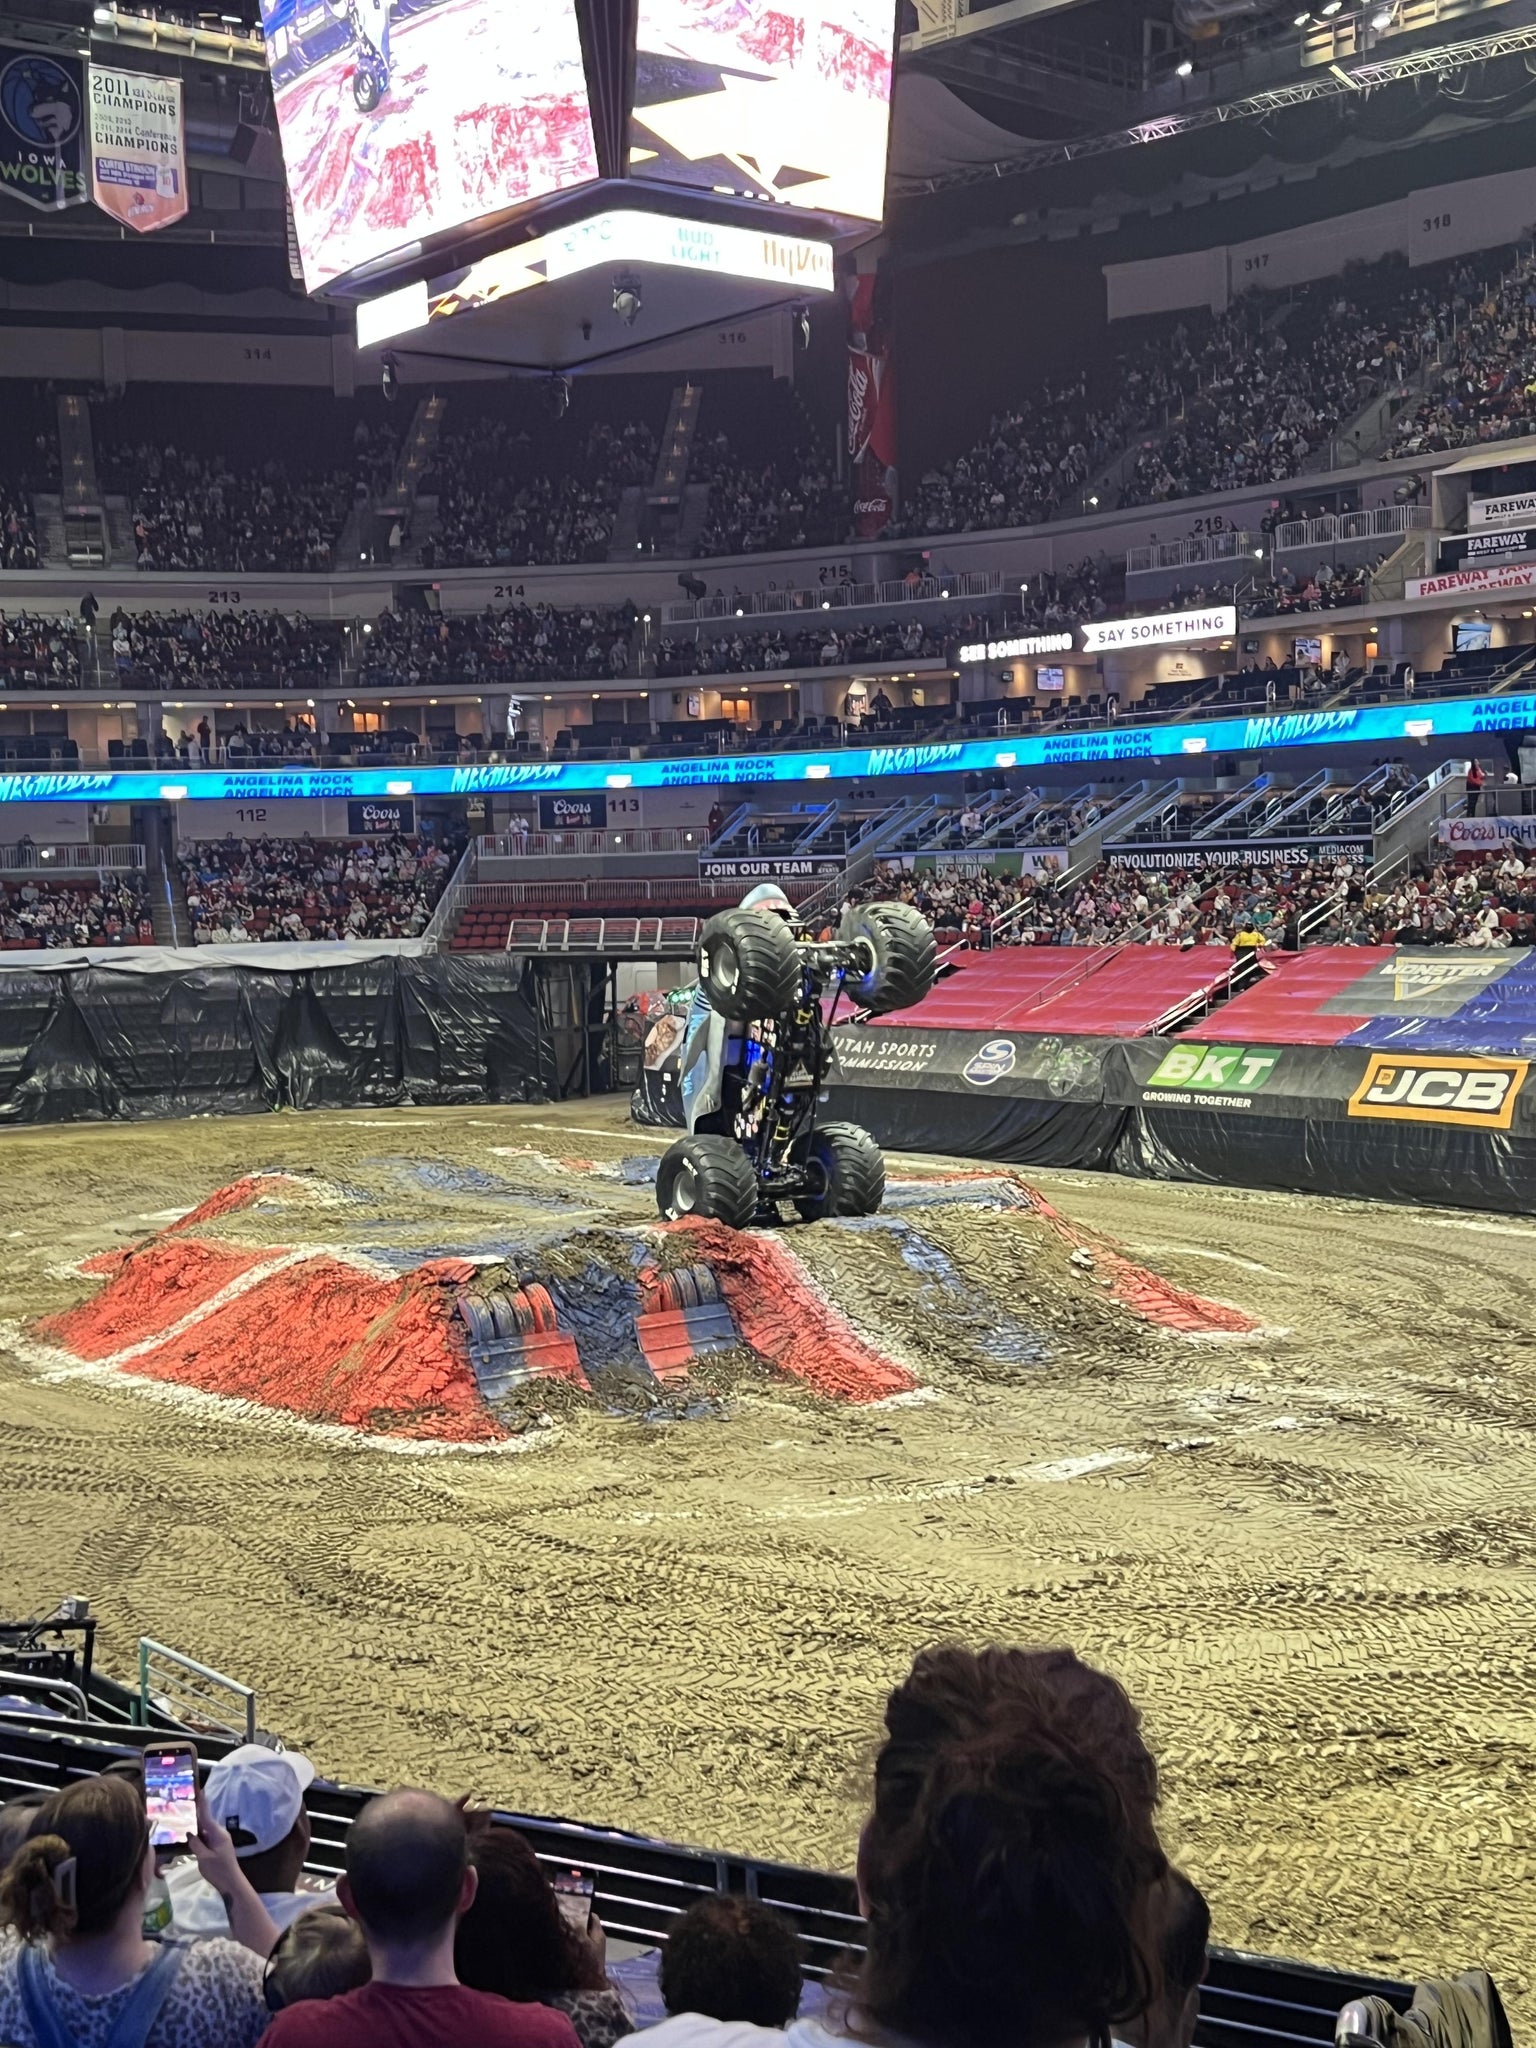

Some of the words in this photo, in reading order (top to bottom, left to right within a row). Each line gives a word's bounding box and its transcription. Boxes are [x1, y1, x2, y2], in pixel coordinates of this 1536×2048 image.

[93, 76, 129, 96] 2011
[94, 93, 176, 116] CHAMPIONS
[96, 132, 178, 154] CHAMPIONS
[18, 150, 66, 168] IOWA
[0, 161, 86, 192] WOLVES
[1486, 498, 1536, 514] FAREWA
[1194, 516, 1223, 533] 216
[1468, 532, 1527, 550] FAREWAY
[818, 564, 849, 578] 215
[494, 584, 525, 598] 214
[1420, 570, 1489, 596] FAREWAY
[208, 591, 241, 604] 213
[1099, 630, 1126, 644] SAY
[1131, 616, 1224, 640] SOMETHING
[960, 644, 986, 662] SEE
[988, 632, 1073, 660] SOMETHING
[1044, 735, 1108, 750] ANGELINA
[1113, 732, 1152, 744] NOCK
[1044, 749, 1108, 764] ANGELINA
[662, 760, 730, 774] ANGELINA
[734, 759, 774, 770] NOCK
[224, 776, 304, 786] ANGELINA
[309, 775, 354, 785] NOCK
[662, 773, 730, 786] ANGELINA
[224, 788, 304, 798] ANGELINA
[362, 804, 400, 820] Coors
[553, 799, 591, 814] Coors
[608, 800, 640, 812] 113
[236, 808, 267, 822] 112
[1450, 822, 1495, 840] Coors
[1318, 845, 1364, 854] MEDIACOM
[1110, 852, 1200, 868] REVOLUTIONIZE
[1205, 851, 1240, 866] YOUR
[1244, 849, 1309, 864] BUSINESS
[704, 864, 736, 876] JOIN
[740, 863, 770, 875] OUR
[774, 862, 812, 874] TEAM
[1380, 964, 1496, 976] MONSTER
[1398, 974, 1464, 985] JAM
[833, 1036, 875, 1054] UTAH
[878, 1042, 936, 1058] SPORTS
[838, 1056, 928, 1072] OMMISSION
[1158, 1052, 1274, 1084] BKT
[1366, 1070, 1510, 1110] JCB
[1142, 1091, 1191, 1104] GROWING
[1194, 1094, 1252, 1108] TOGETHER
